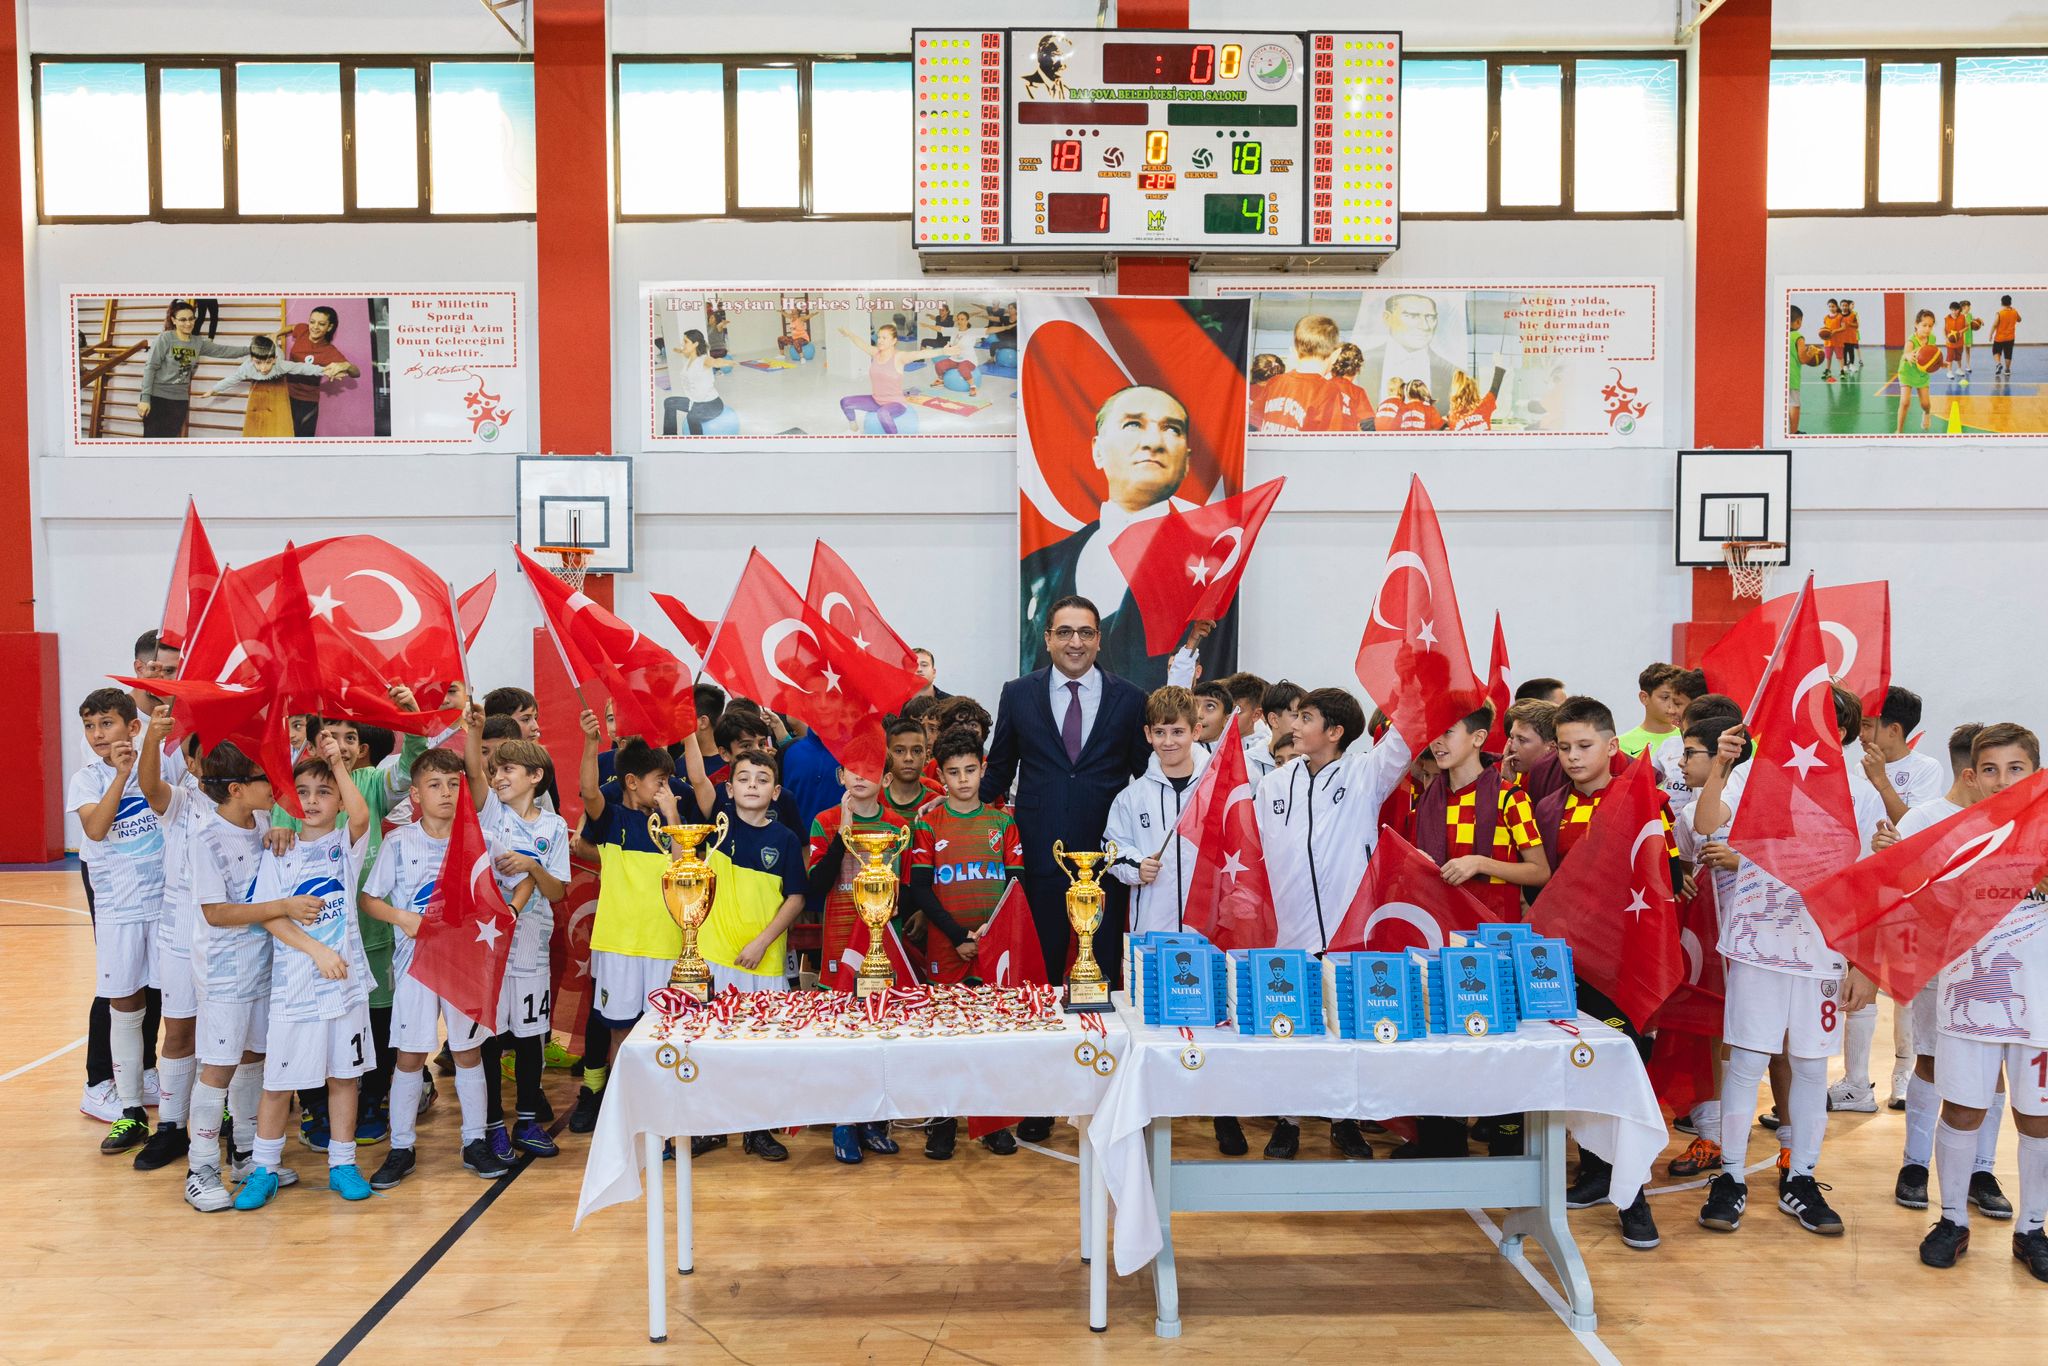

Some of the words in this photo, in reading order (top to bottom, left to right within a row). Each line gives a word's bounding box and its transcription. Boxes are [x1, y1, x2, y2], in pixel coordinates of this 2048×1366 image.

[1070, 89, 1116, 103] BALÇOVA
[1118, 86, 1176, 100] BELEDİYESİ
[1178, 90, 1204, 100] SPOR
[1205, 90, 1247, 101] SALONU
[1052, 141, 1080, 171] 18
[1233, 142, 1260, 174] 18
[1035, 191, 1045, 235] SKOR
[1100, 196, 1108, 230] 1
[1242, 198, 1264, 231] 4
[1269, 192, 1279, 235] SKOR
[412, 300, 432, 308] Bir
[438, 300, 488, 308] Milletin
[666, 298, 702, 311] Her
[708, 298, 775, 313] Yaştan
[780, 298, 850, 311] Herkes
[856, 294, 894, 312] İçin
[902, 297, 947, 312] Spor
[1520, 297, 1566, 306] Açtığın
[1571, 296, 1610, 306] yolda,
[428, 312, 474, 322] Sporda
[1504, 308, 1577, 318] gösterdiğin
[1582, 308, 1626, 317] hedefe
[398, 324, 466, 334] Gösterdiği
[471, 324, 503, 333] Azim
[1520, 321, 1539, 330] hiç
[1544, 321, 1610, 329] durmadan
[396, 337, 430, 345] Onun
[436, 337, 505, 346] Geleceğini
[1519, 333, 1610, 343] yürüyeceğime
[419, 349, 484, 357] Yükseltir.
[1524, 345, 1548, 353] and
[1553, 345, 1595, 355] içerim
[523, 990, 550, 1024] 14
[465, 1008, 482, 1039] 7
[1820, 1000, 1837, 1032] 8
